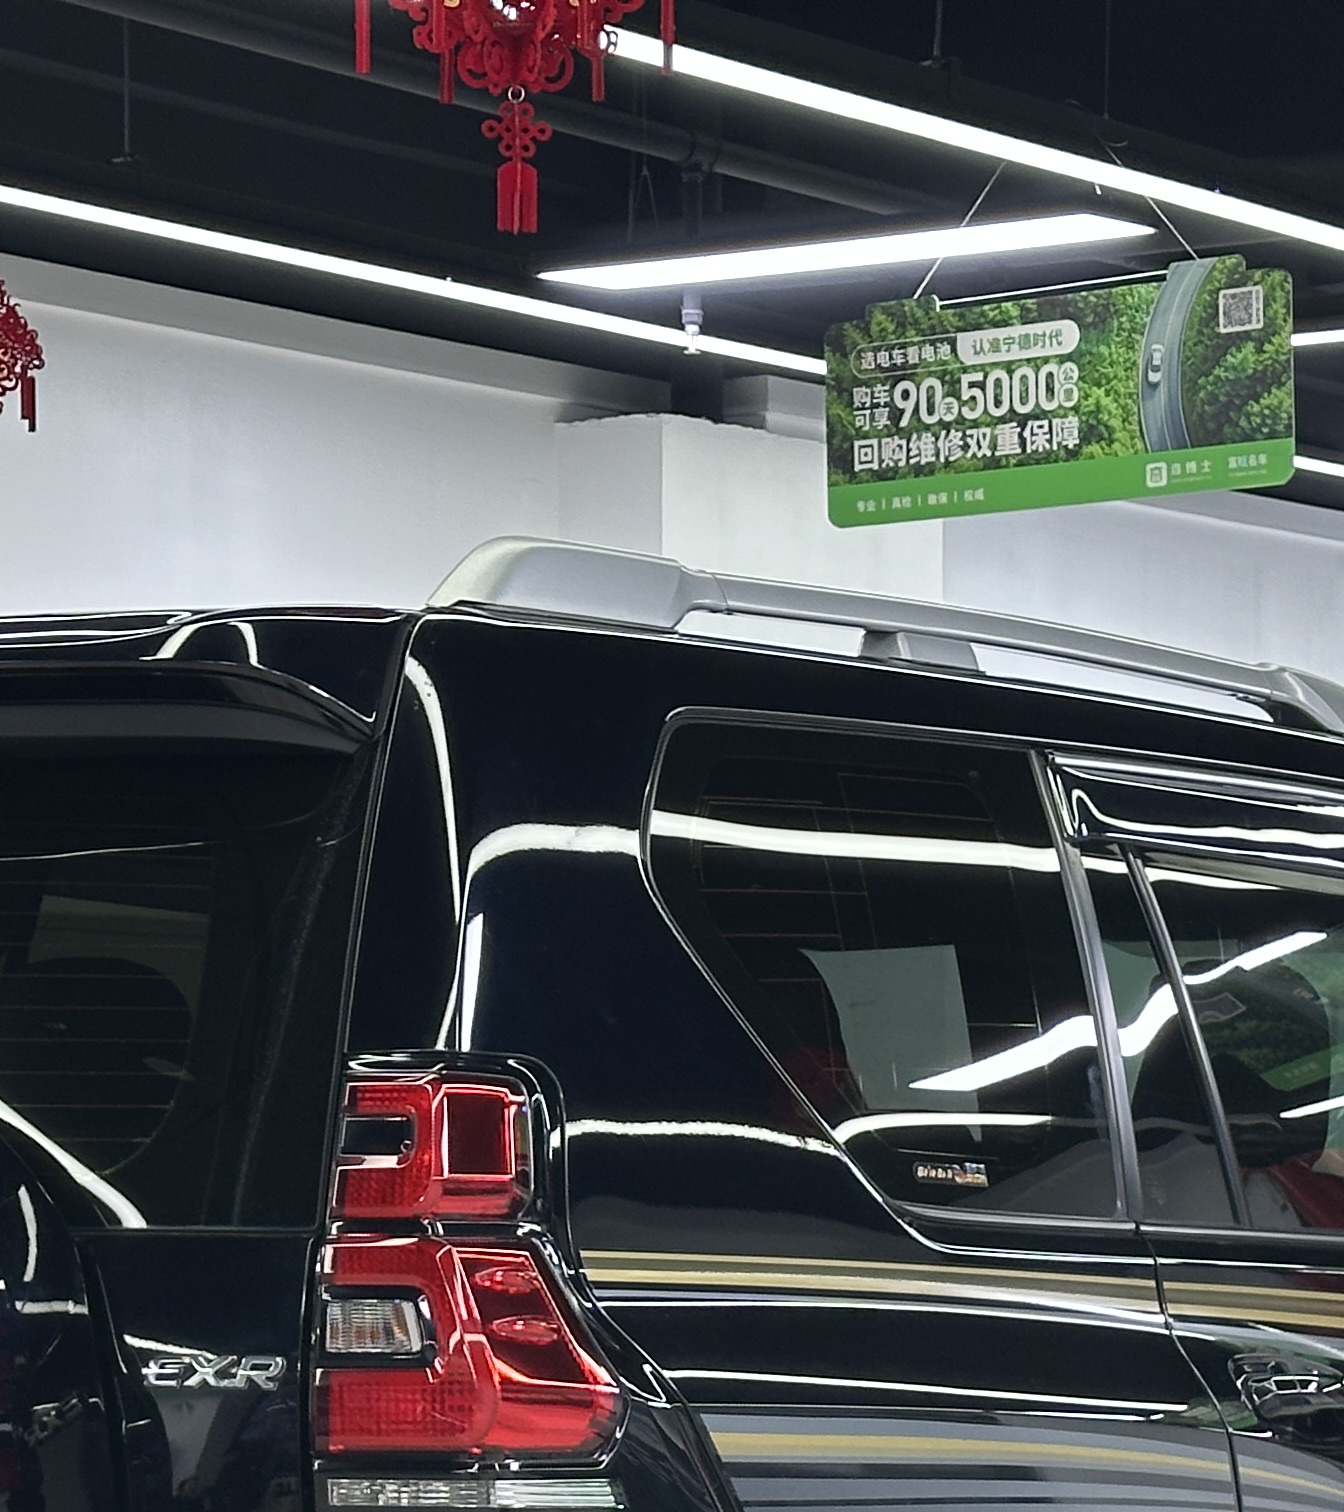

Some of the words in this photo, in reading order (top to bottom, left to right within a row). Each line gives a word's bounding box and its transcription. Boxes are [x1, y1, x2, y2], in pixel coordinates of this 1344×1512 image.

[860, 341, 951, 370] 选电车看电池
[972, 328, 1063, 356] 认准宁德时代
[853, 415, 1080, 472] 回购维修双重保障
